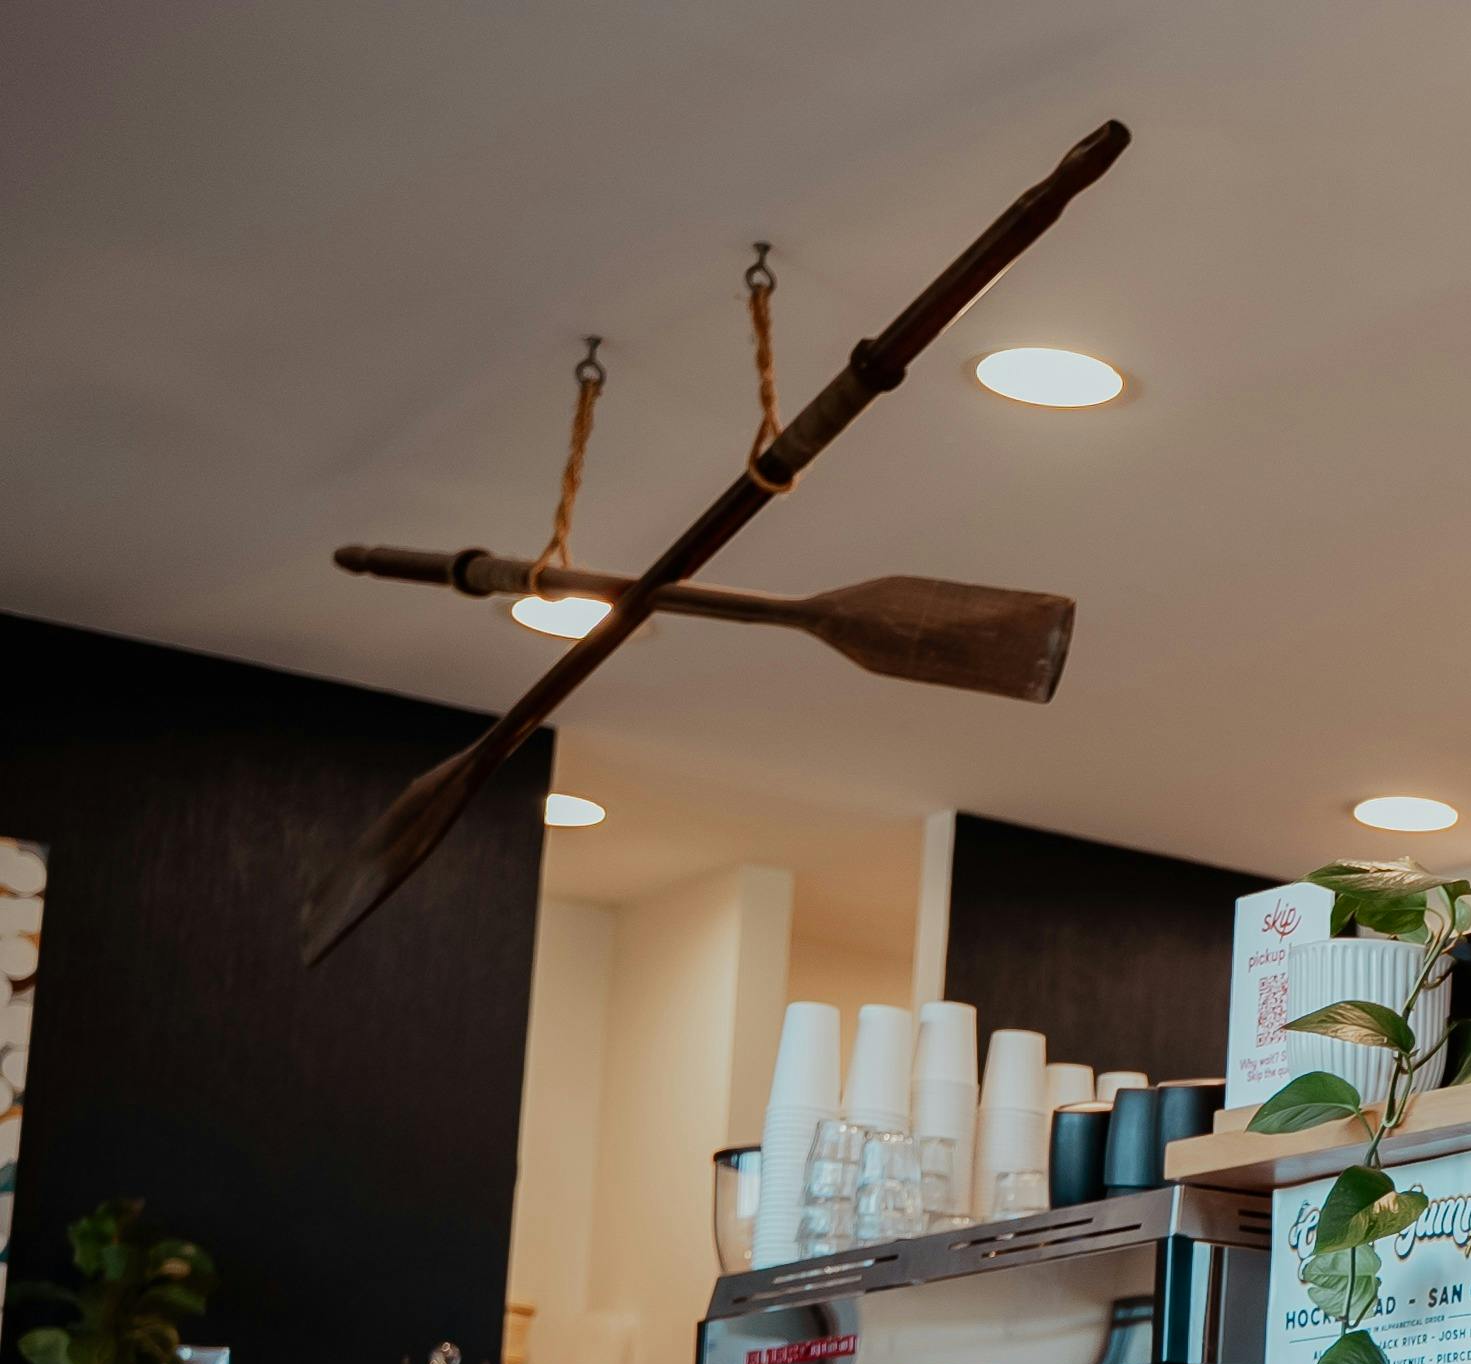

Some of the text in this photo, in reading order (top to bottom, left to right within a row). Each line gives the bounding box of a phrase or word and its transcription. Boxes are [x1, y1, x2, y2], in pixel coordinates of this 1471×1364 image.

[1261, 899, 1301, 942] skip
[1249, 949, 1285, 975] pickup
[1428, 1283, 1462, 1308] SAN
[1401, 1334, 1427, 1347] RIVER
[1438, 1329, 1466, 1342] JOSH
[1437, 1348, 1471, 1363] PIERCE
